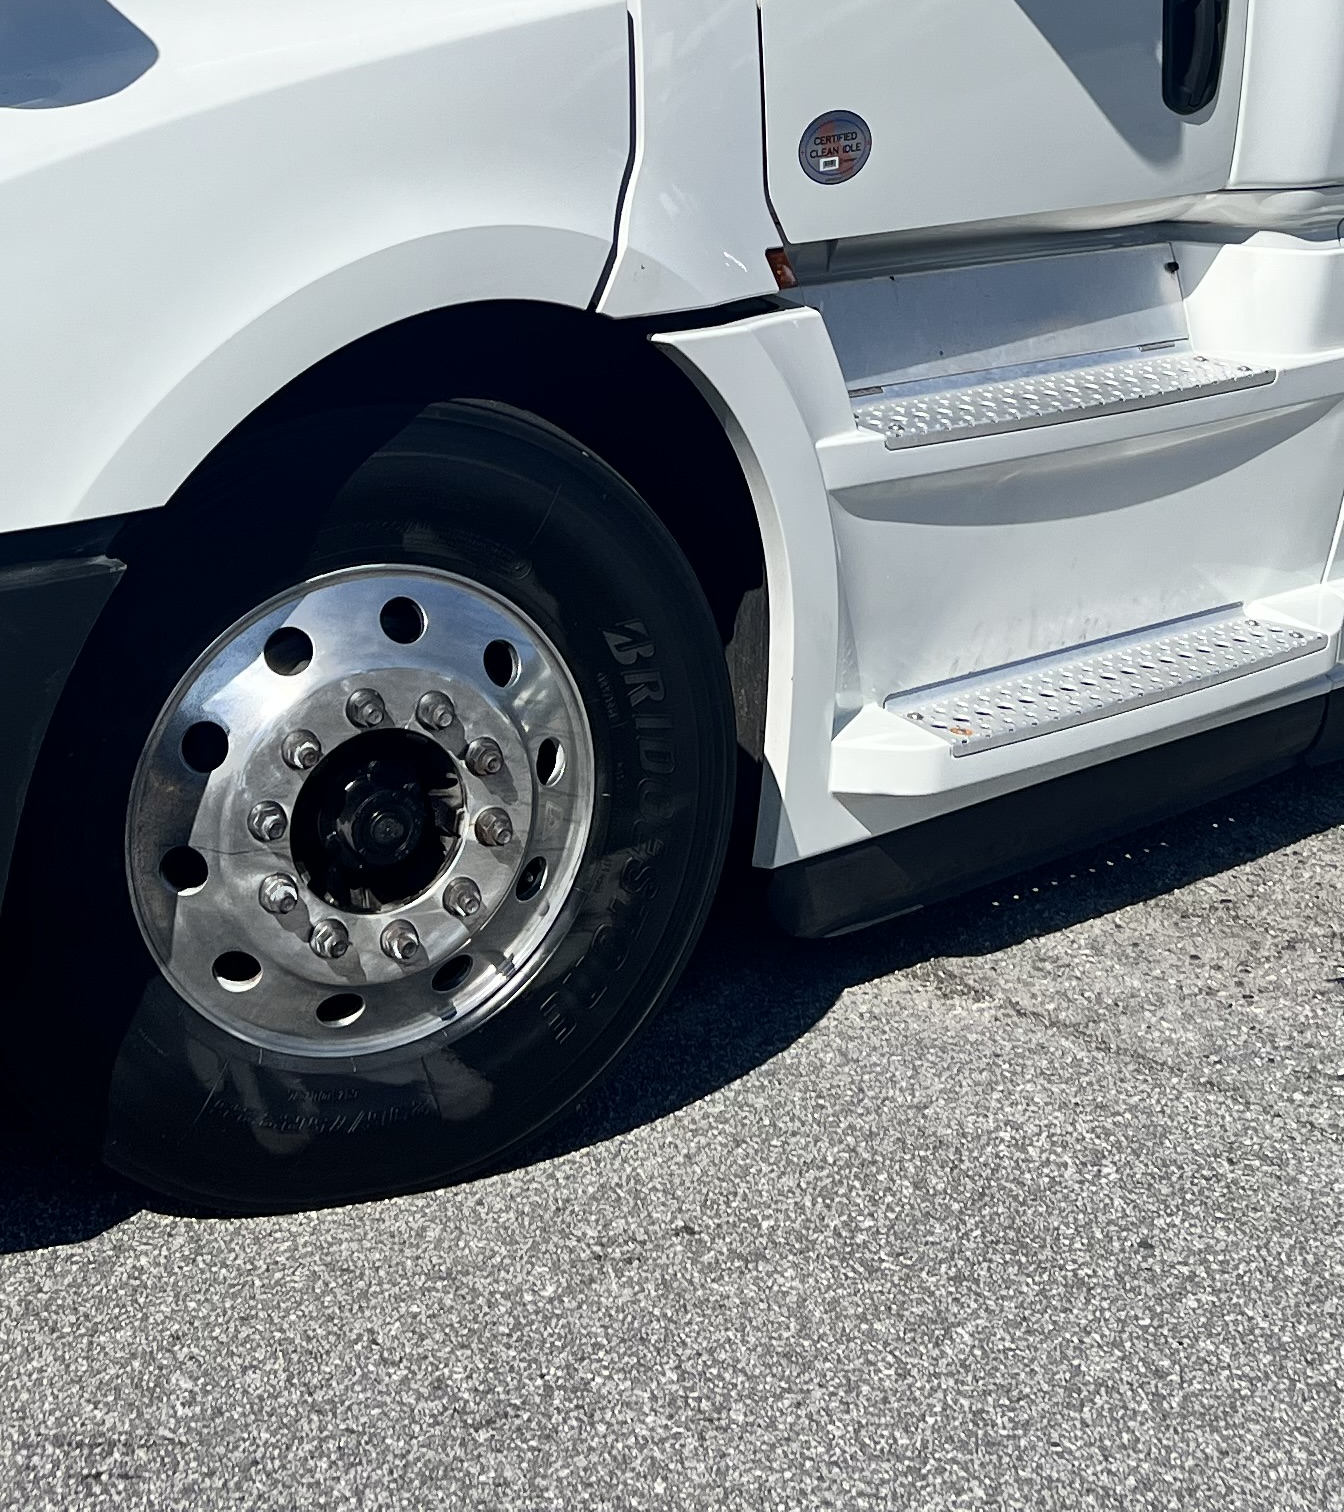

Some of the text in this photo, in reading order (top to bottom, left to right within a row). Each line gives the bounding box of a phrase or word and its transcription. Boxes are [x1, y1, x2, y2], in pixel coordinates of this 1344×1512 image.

[814, 131, 858, 146] CERTIFIED
[810, 142, 861, 159] CLEAN IDLE
